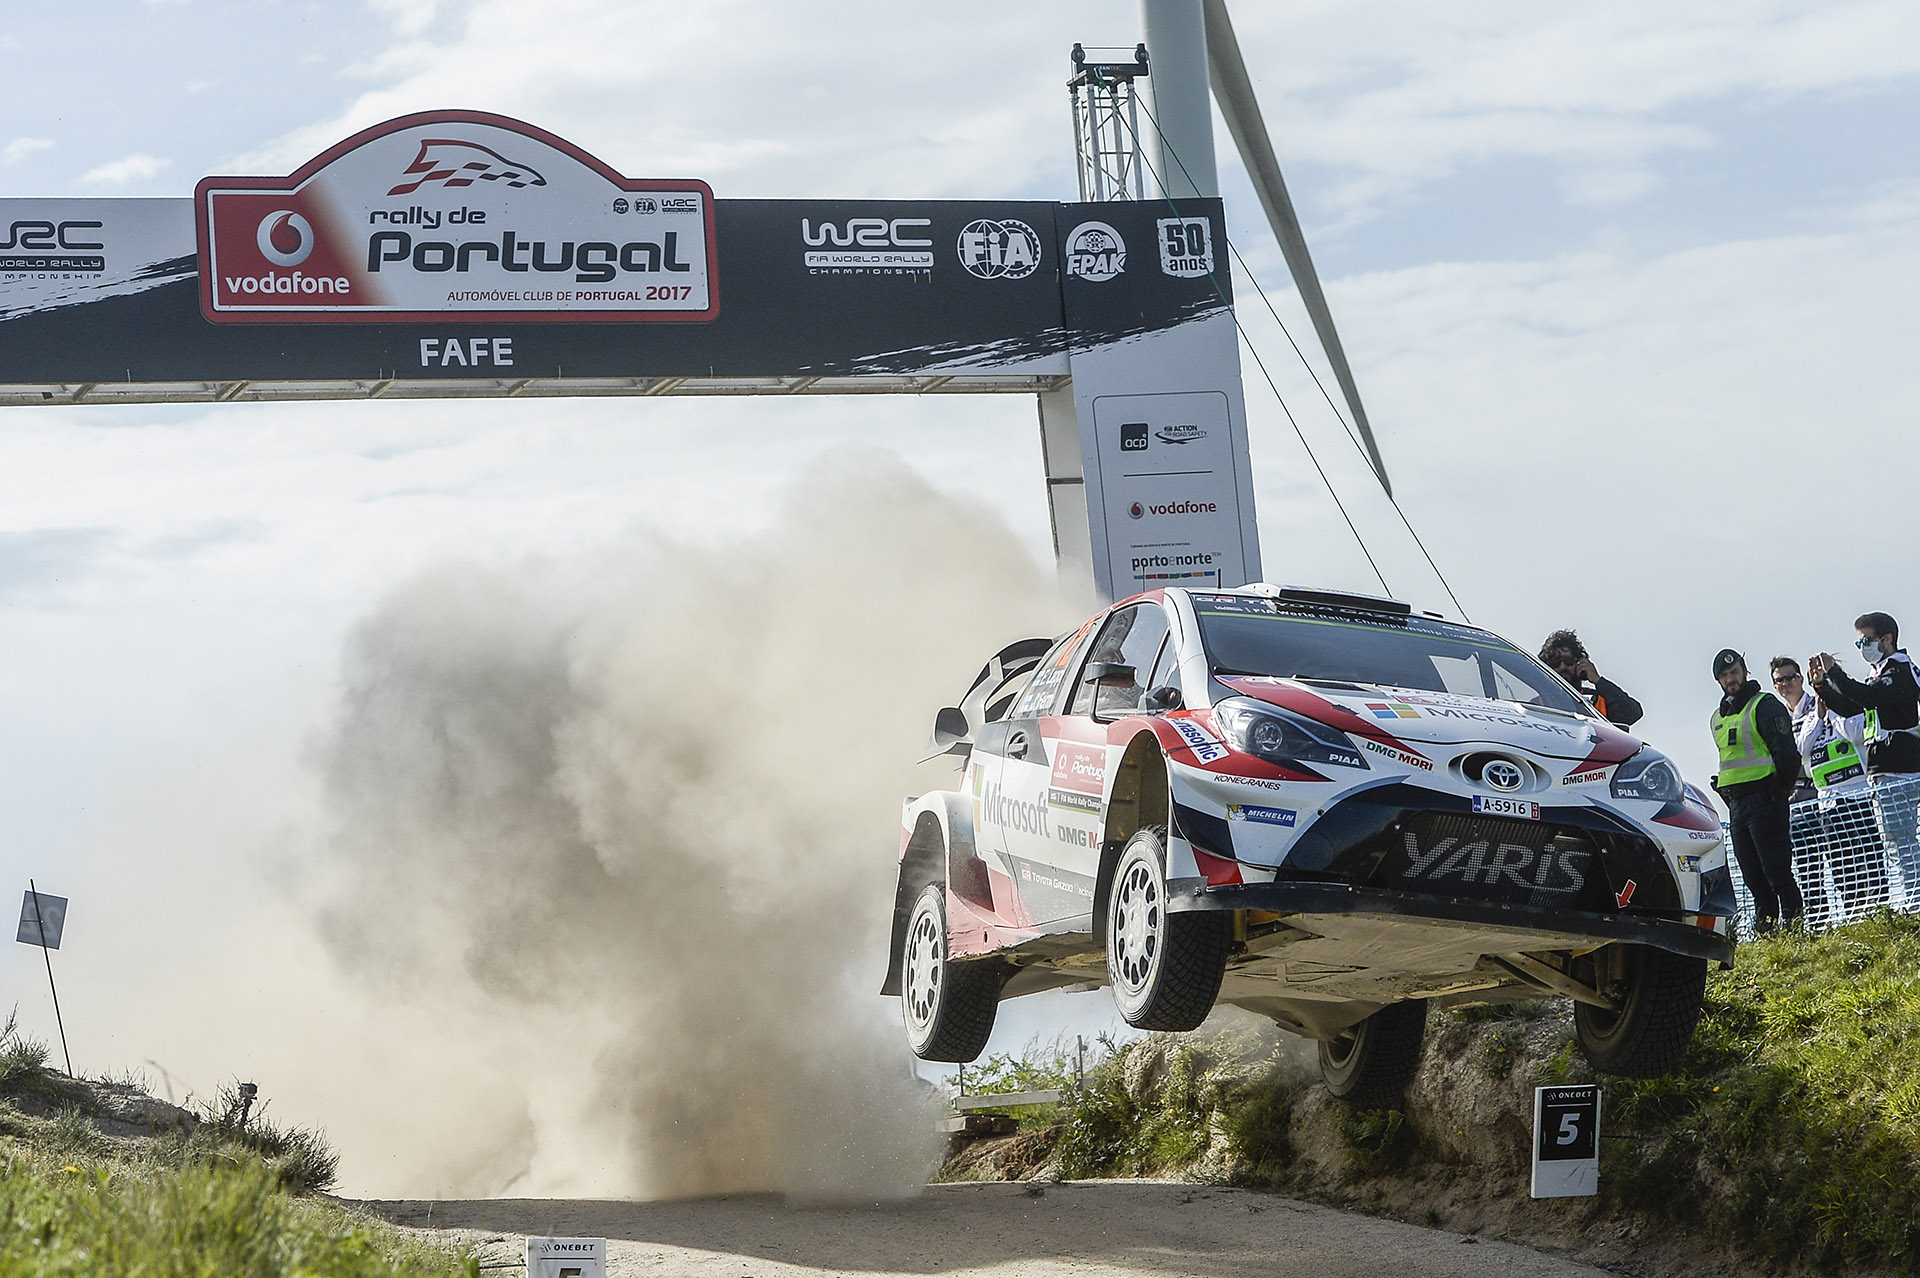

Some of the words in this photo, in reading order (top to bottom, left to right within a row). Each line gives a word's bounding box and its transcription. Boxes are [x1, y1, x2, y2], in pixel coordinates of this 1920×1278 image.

[661, 199, 697, 207] WRC
[369, 206, 442, 229] rally
[447, 206, 486, 224] de
[801, 218, 933, 247] WRC
[1165, 223, 1206, 257] 50
[367, 231, 691, 283] Portugal
[963, 231, 1034, 266] FIA
[50, 260, 101, 268] RALLY
[808, 255, 829, 263] FIA
[832, 255, 880, 263] WORLD
[884, 255, 930, 263] RALLY
[1066, 252, 1127, 275] FPAK
[1169, 258, 1207, 271] anos
[225, 271, 350, 294] vodafone
[447, 288, 520, 301] AUTOMÓVEL
[523, 290, 553, 301] CLUB
[556, 290, 571, 301] DE
[575, 290, 641, 301] PORTUGAL
[645, 286, 692, 301] 2017
[419, 338, 514, 367] FAFE
[1125, 438, 1147, 449] acp
[1149, 501, 1217, 515] vodafone
[1424, 707, 1577, 739] Microsoft
[1328, 754, 1360, 766] PIAA
[1365, 741, 1397, 759] DMG
[1398, 753, 1434, 771] MORI
[1071, 760, 1105, 781] Portug
[1562, 775, 1583, 786] DMG
[1584, 771, 1607, 783] MORI
[1213, 774, 1281, 791] KONECRANES
[1617, 789, 1640, 798] PIAA
[984, 781, 1051, 839] Microsoft
[1483, 798, 1526, 815] A-5916
[1247, 809, 1294, 822] MICHELIN
[1058, 825, 1086, 847] DMG
[1558, 1091, 1593, 1099] ONEBET
[1556, 1112, 1581, 1146] 5
[553, 1244, 595, 1252] ONEBET
